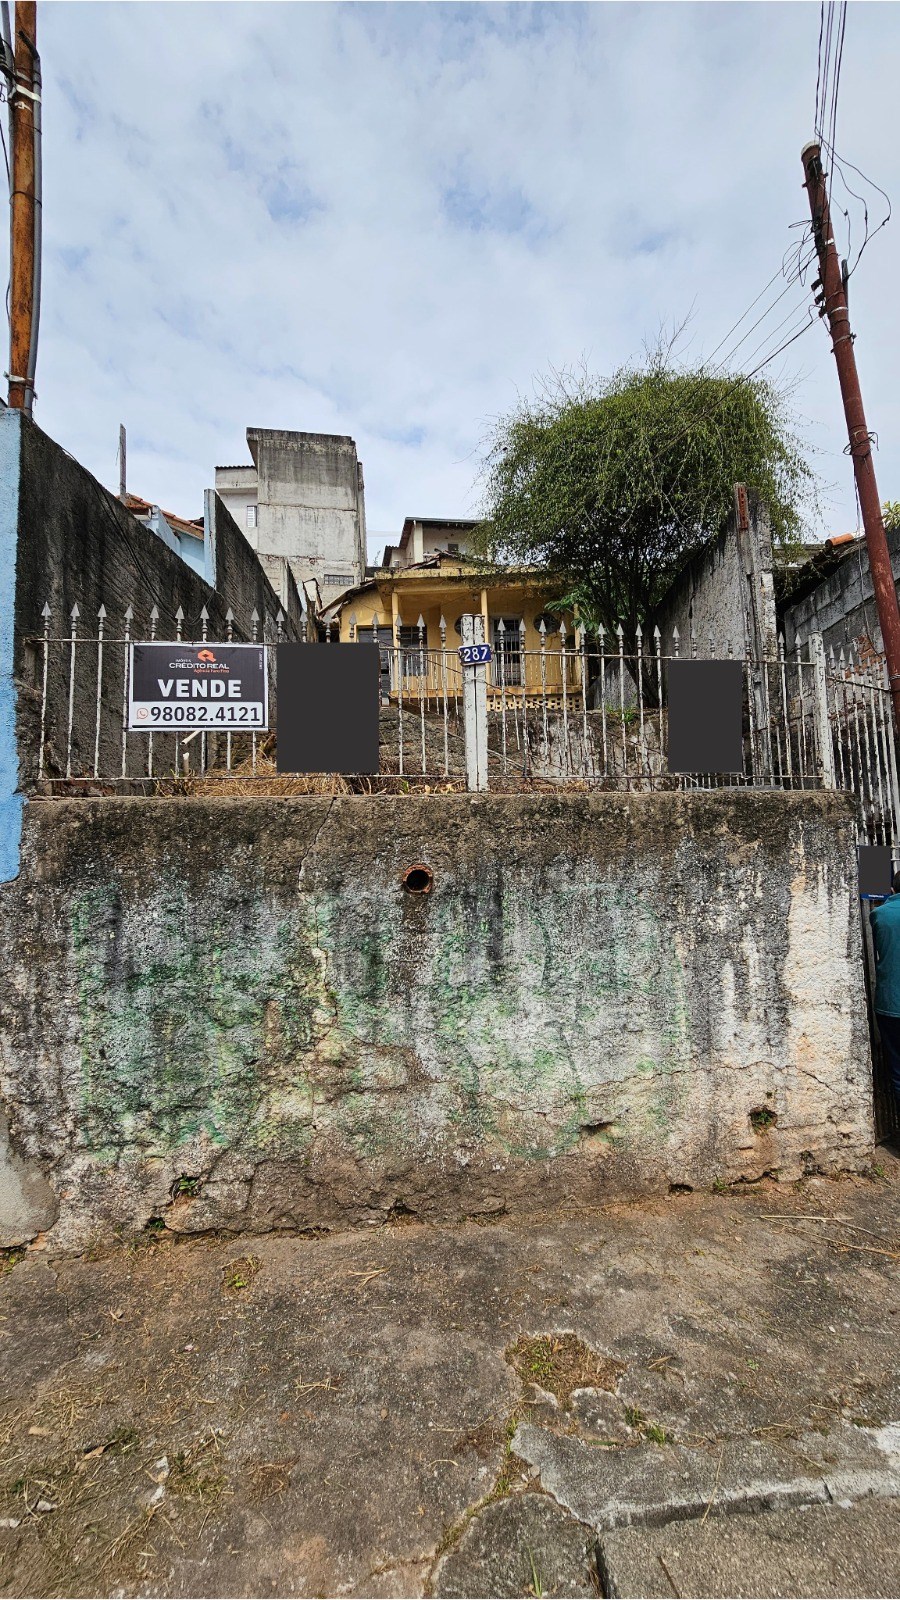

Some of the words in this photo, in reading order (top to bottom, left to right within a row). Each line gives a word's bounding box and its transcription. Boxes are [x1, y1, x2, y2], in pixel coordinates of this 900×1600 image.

[464, 647, 487, 661] 287
[157, 679, 242, 698] VENDE
[150, 706, 260, 722] 98082.4121
